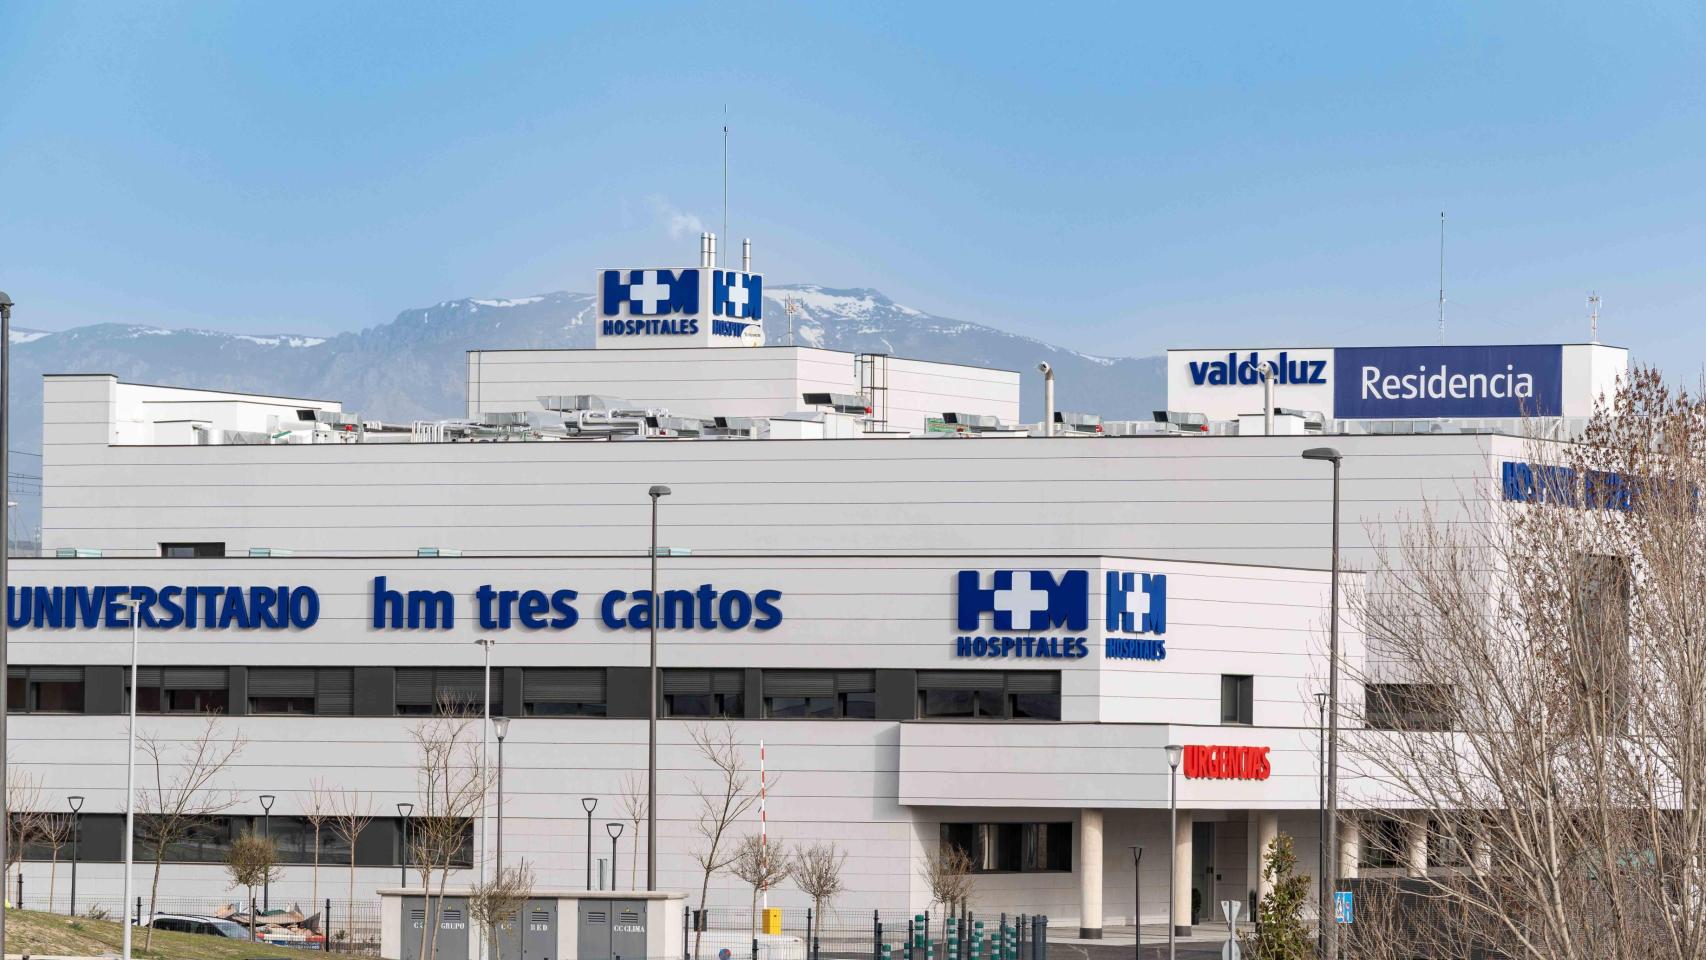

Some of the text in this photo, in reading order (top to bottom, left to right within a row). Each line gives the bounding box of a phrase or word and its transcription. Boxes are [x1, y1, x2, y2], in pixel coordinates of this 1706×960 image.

[603, 319, 699, 335] HOSPITALES
[1362, 364, 1533, 400] Residencia
[7, 576, 783, 630] UNIVERSITARIO hm tres cantos
[957, 636, 1089, 659] HOSPITALES
[1105, 638, 1167, 660] HOSPITALES
[1184, 745, 1270, 780] URGENCIAS
